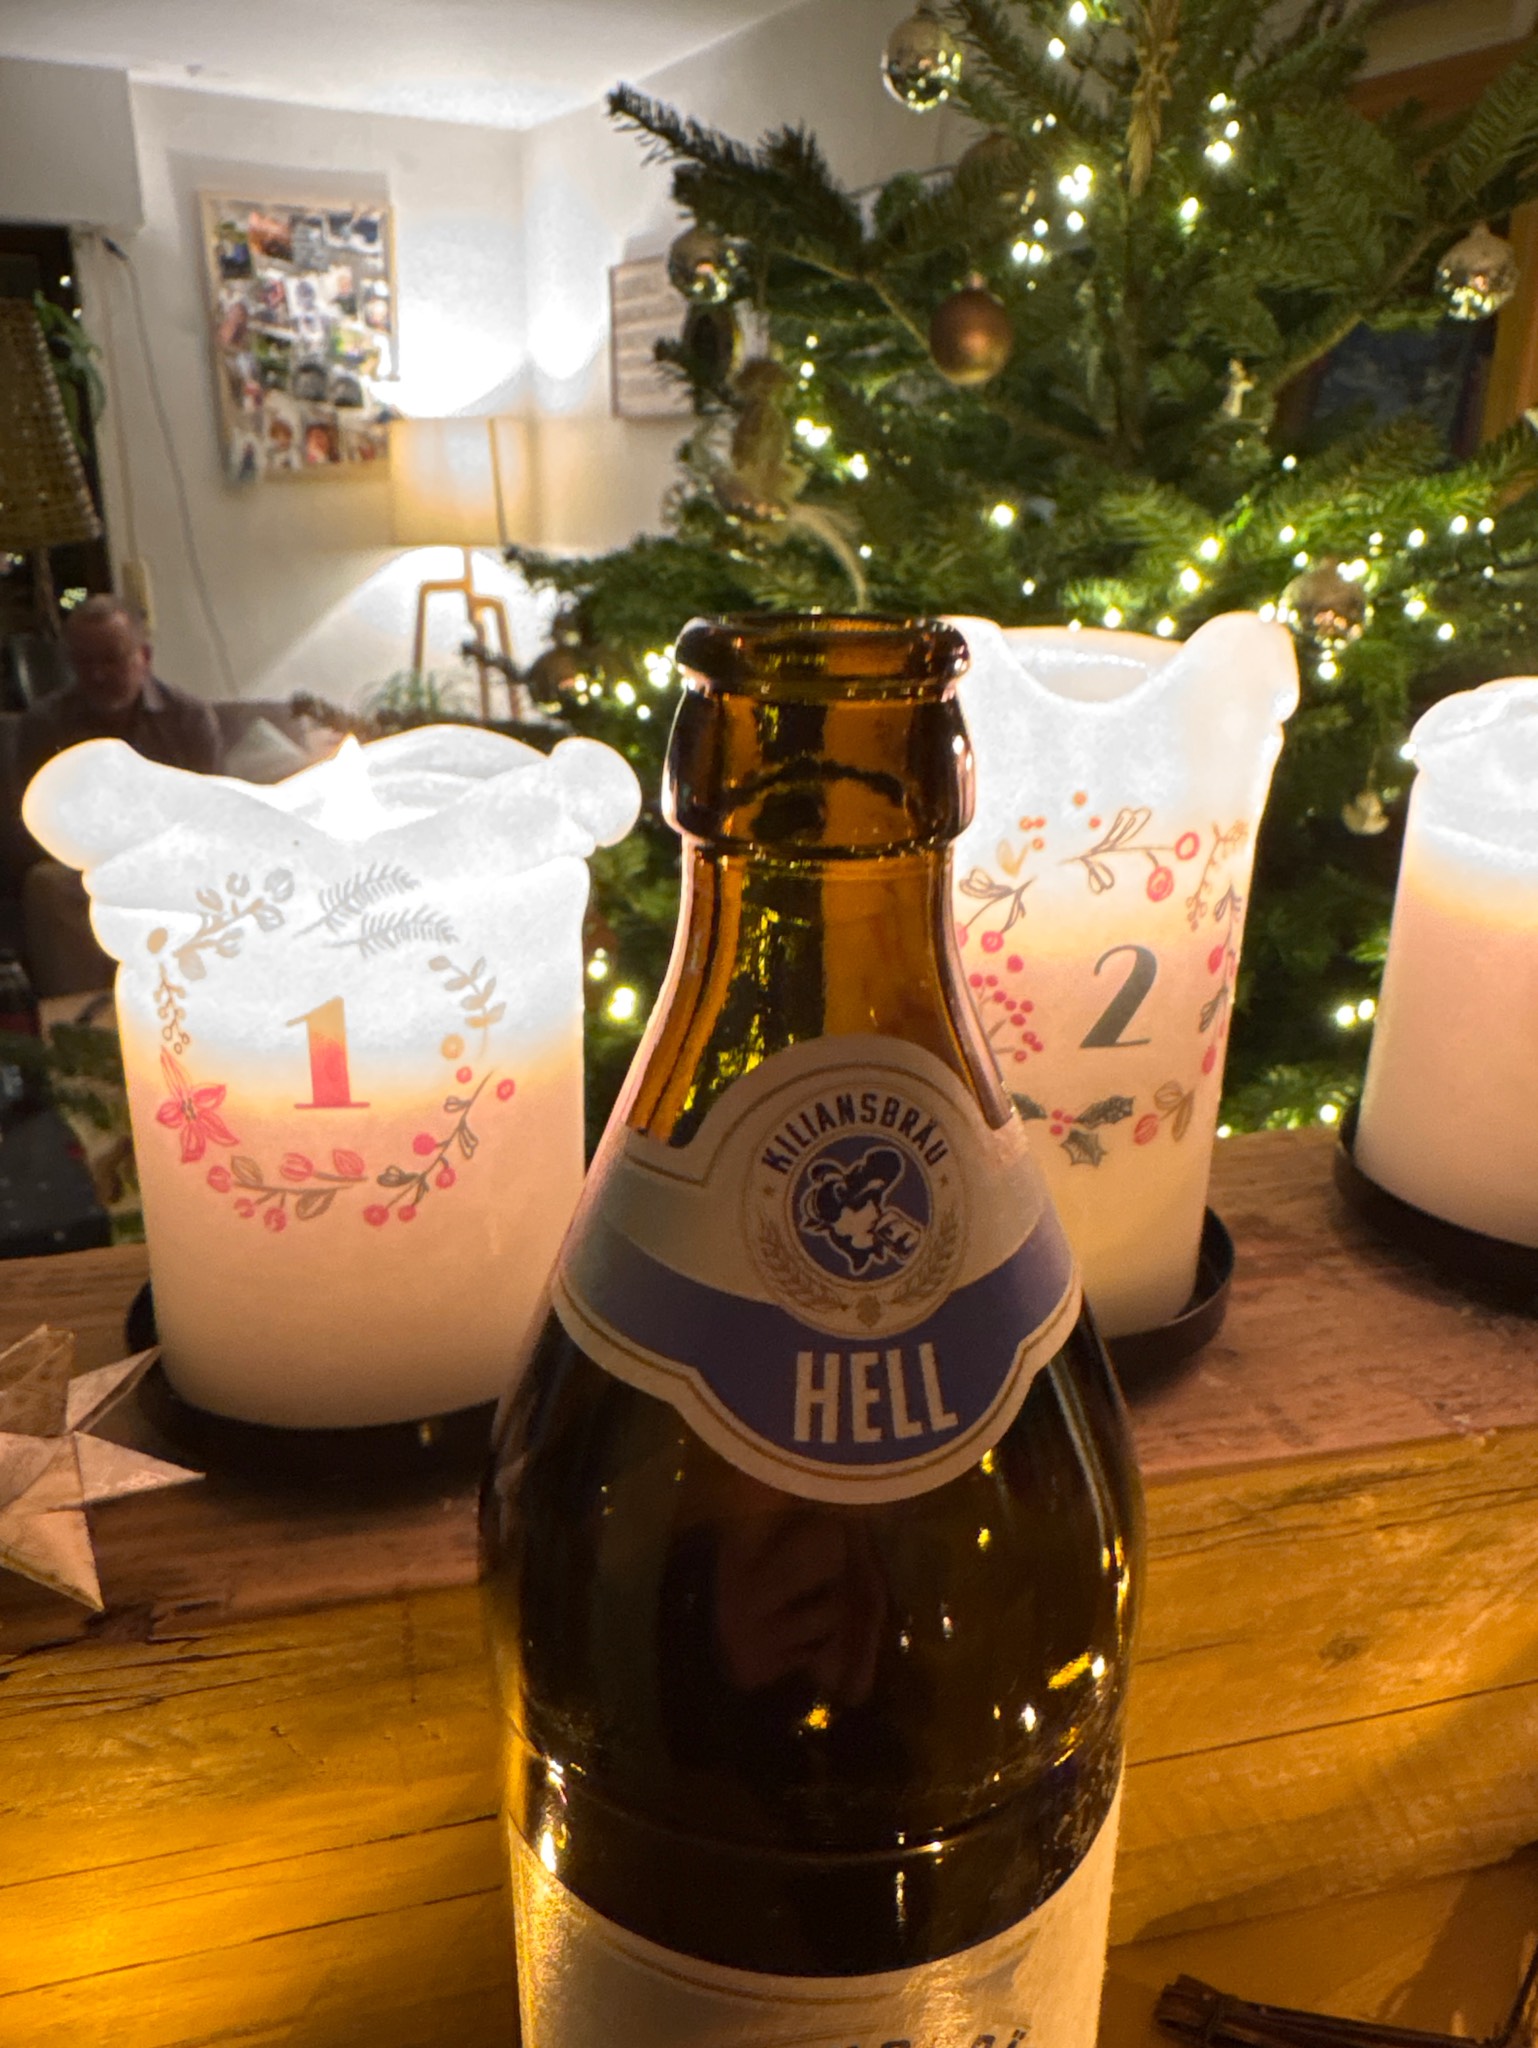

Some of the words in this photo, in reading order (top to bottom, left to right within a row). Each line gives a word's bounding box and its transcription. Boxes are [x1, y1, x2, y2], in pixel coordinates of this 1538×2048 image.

[1080, 944, 1159, 1049] 2
[286, 995, 370, 1110] 1
[761, 1092, 949, 1175] KILIANSBRÄU
[794, 1342, 959, 1444] HELL
